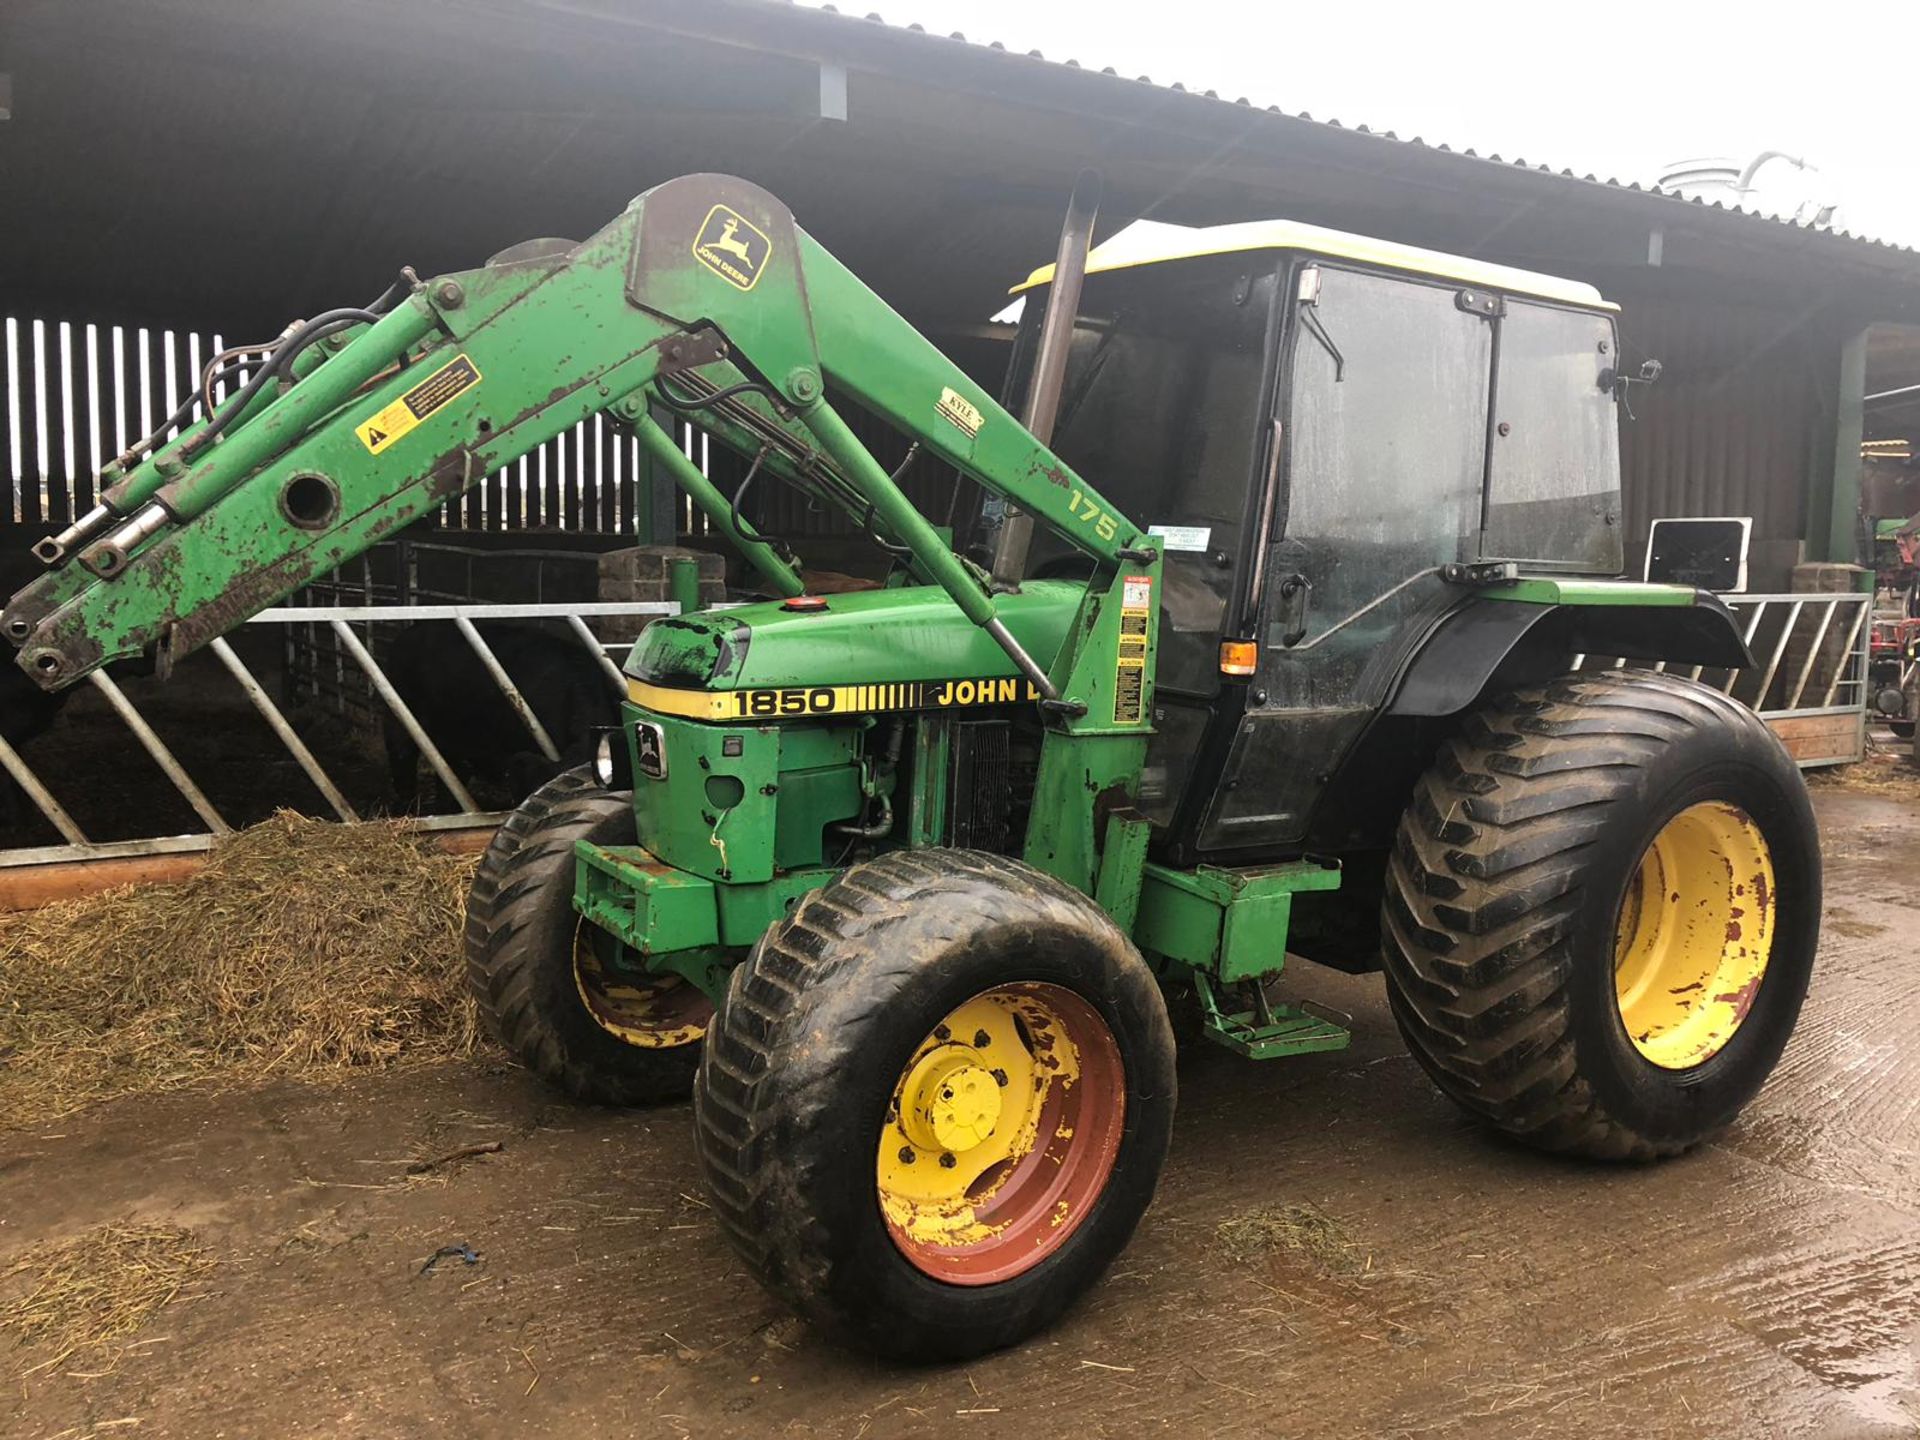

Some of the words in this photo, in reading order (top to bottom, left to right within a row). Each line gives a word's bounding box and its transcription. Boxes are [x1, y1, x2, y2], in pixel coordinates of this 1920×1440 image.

[697, 246, 722, 266] JOHN
[720, 262, 750, 286] DEERE
[949, 396, 974, 418] KYLE
[1068, 489, 1119, 541] 175
[735, 688, 836, 716] 1850
[938, 679, 1016, 705] JOHN
